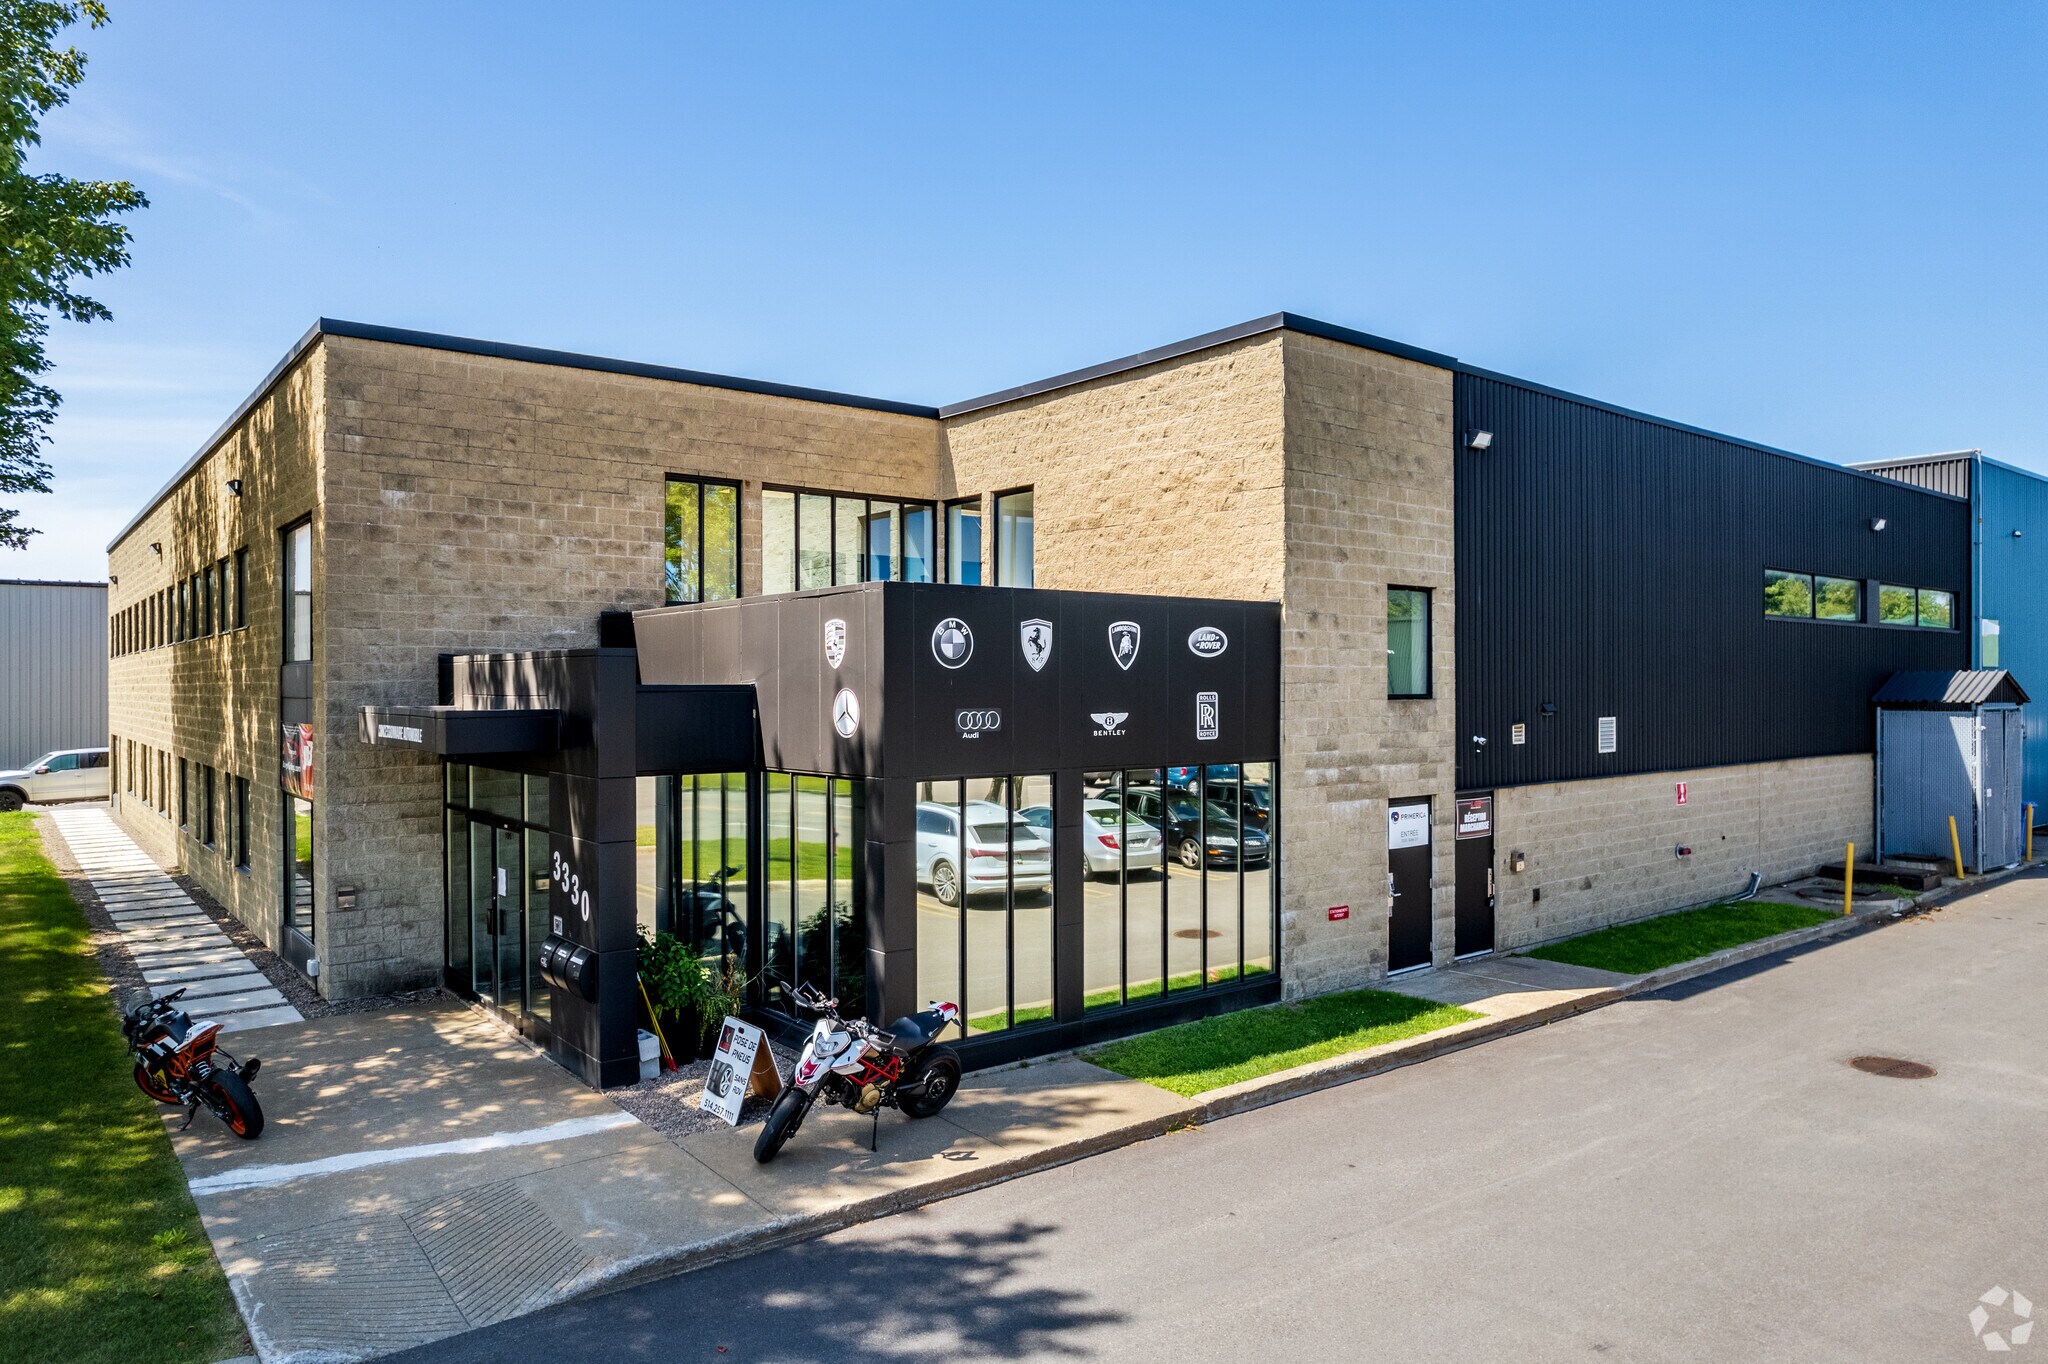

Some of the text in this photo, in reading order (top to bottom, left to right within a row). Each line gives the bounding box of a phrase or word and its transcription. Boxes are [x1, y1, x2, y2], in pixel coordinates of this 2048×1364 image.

[937, 621, 969, 636] BMW
[1198, 633, 1216, 642] LAND
[1199, 641, 1221, 650] ROVER
[1199, 730, 1216, 738] ROYCE
[1400, 811, 1427, 821] PRIMERICA
[553, 850, 590, 922] 3330
[734, 1035, 748, 1047] POSE
[747, 1041, 758, 1052] DE
[732, 1049, 751, 1064] PNEUS
[733, 1073, 747, 1086] SANS
[704, 1099, 734, 1120] 514.257.1111
